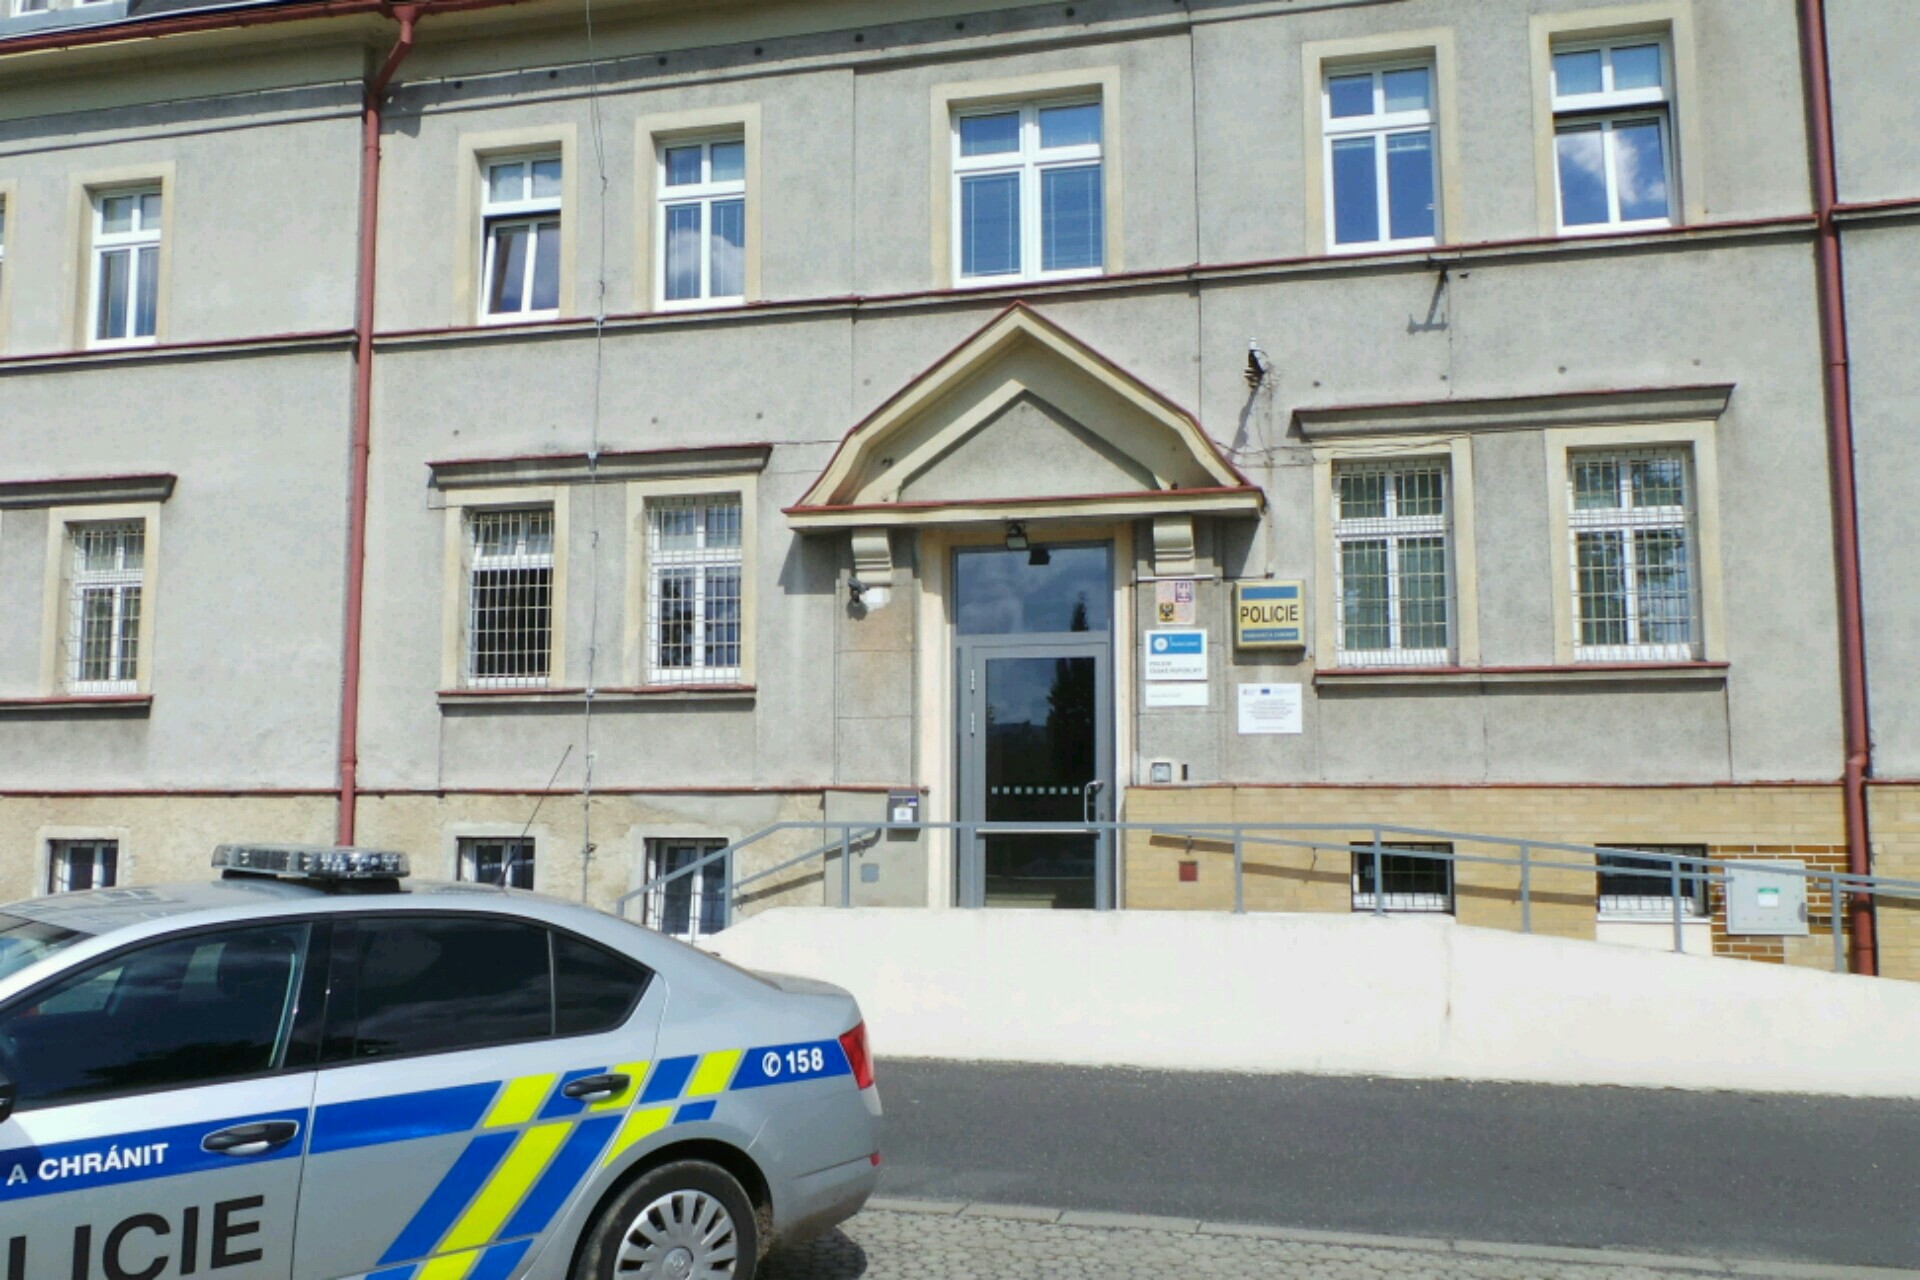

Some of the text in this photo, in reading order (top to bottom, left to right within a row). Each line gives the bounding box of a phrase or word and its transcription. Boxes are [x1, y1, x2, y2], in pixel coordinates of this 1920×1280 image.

[1240, 604, 1299, 623] POLICIE
[785, 1047, 824, 1074] 158
[6, 1142, 170, 1187] A CHRÁNIT
